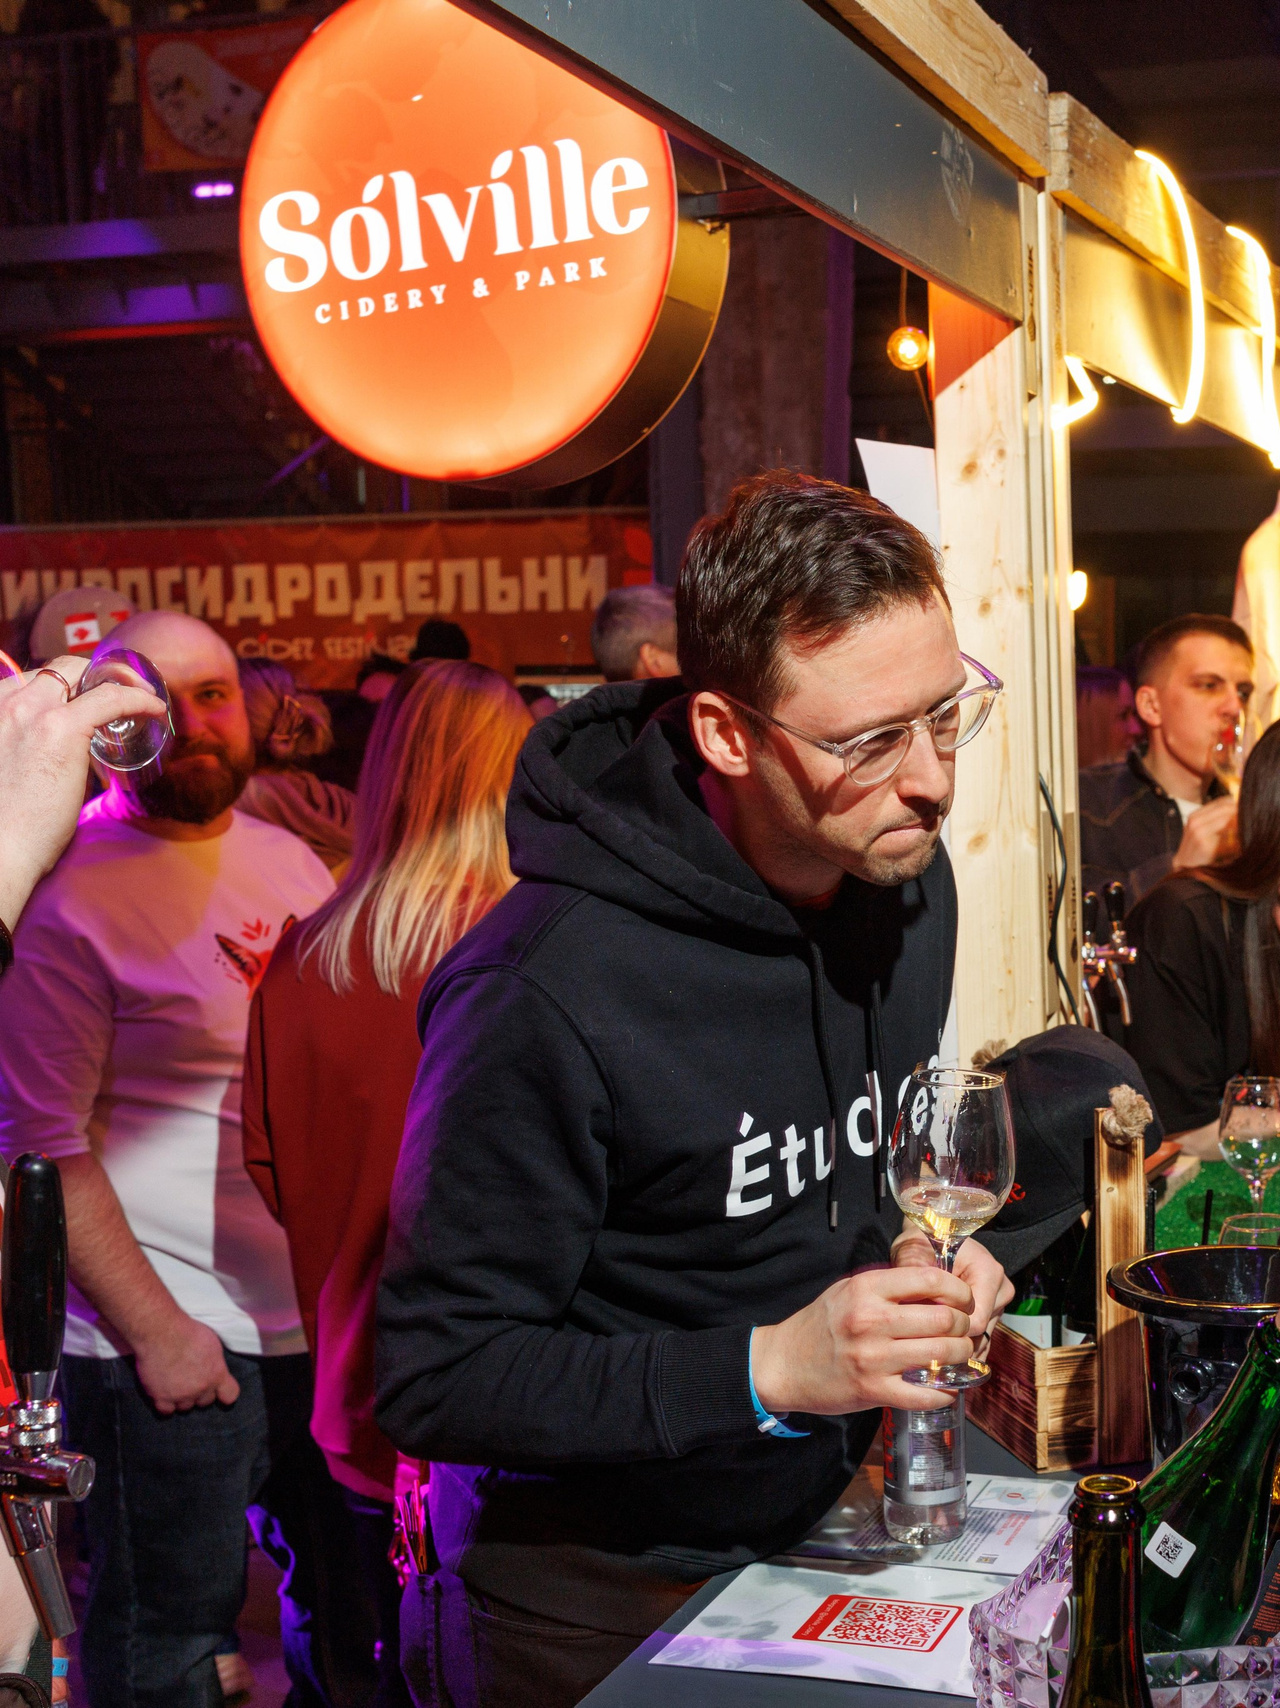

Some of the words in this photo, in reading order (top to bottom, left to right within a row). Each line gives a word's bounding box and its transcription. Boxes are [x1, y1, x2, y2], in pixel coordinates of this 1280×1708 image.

[314, 283, 447, 324] CIDERY
[472, 277, 490, 298] &
[514, 256, 608, 290] PARK
